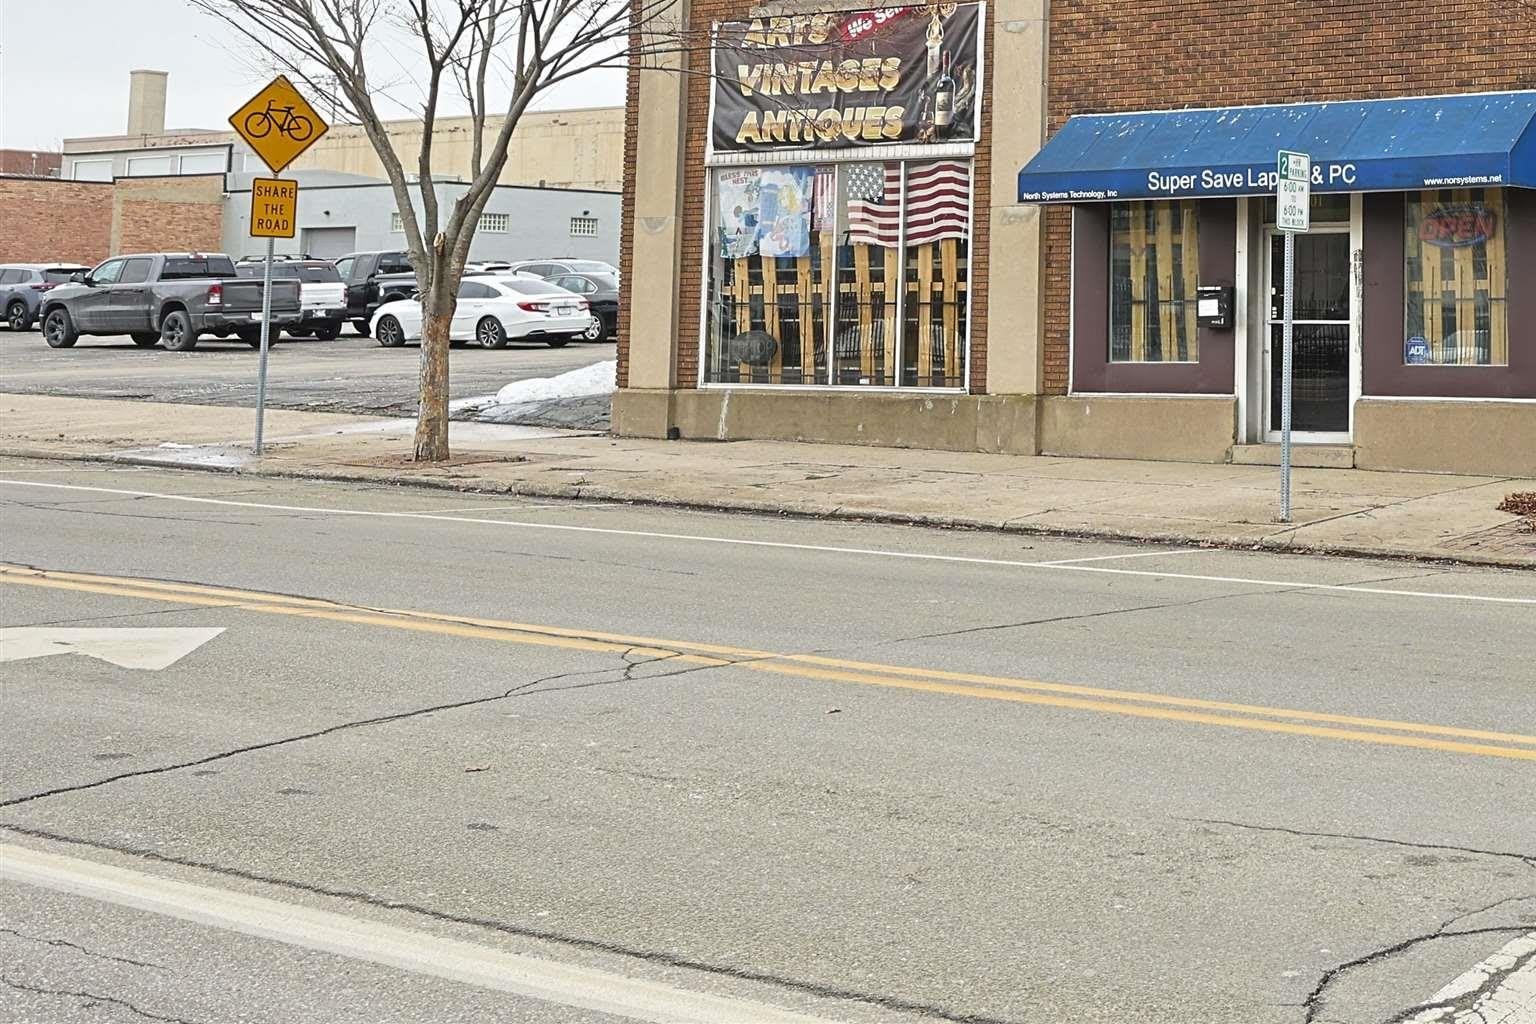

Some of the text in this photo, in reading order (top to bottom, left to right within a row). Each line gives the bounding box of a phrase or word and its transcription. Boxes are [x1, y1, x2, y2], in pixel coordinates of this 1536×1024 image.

[741, 12, 830, 50] ARTS
[847, 17, 873, 38] We
[737, 57, 901, 97] VINTAGES
[735, 105, 905, 144] ANTIQUES
[1281, 157, 1288, 175] 2
[1147, 163, 1357, 194] Super Save Lap & PC
[1423, 174, 1503, 187] www.norsystems.net
[256, 185, 294, 199] SHARE
[1023, 191, 1041, 200] North
[1041, 190, 1069, 201] Systems
[1107, 189, 1118, 198] Inc
[264, 203, 284, 216] THE
[257, 218, 289, 231] ROAD
[1419, 209, 1495, 241] OPEN
[1408, 345, 1425, 355] ADT
